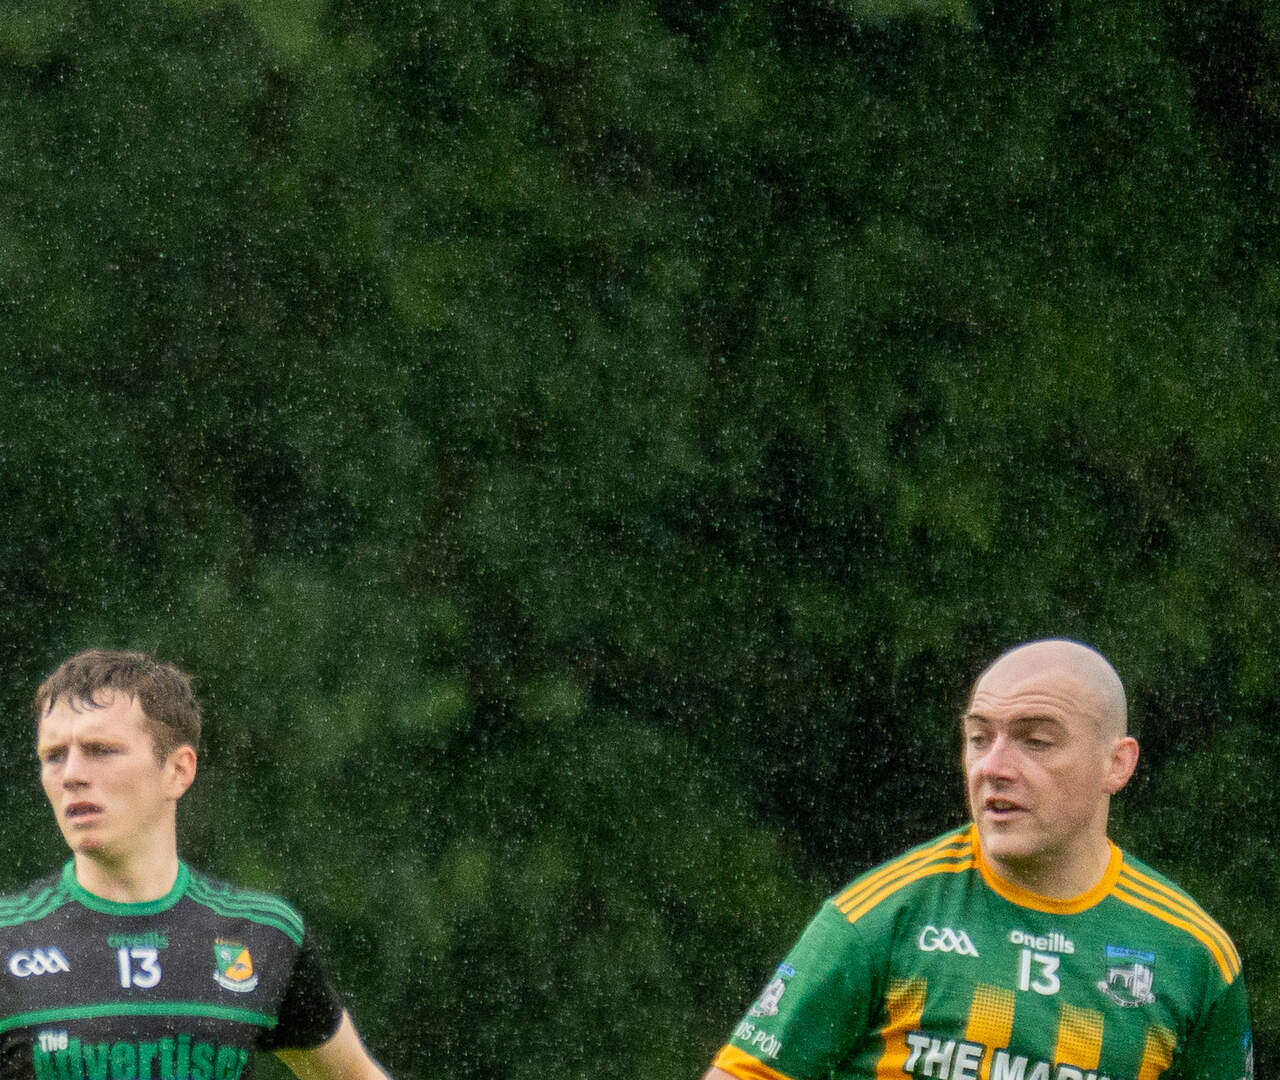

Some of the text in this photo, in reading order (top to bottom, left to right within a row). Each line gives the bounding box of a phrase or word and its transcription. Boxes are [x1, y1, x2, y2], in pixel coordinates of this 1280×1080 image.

[919, 925, 979, 957] GAA
[9, 947, 71, 977] GAA
[117, 945, 162, 988] 13
[1017, 948, 1061, 995] 13
[38, 1029, 69, 1053] The
